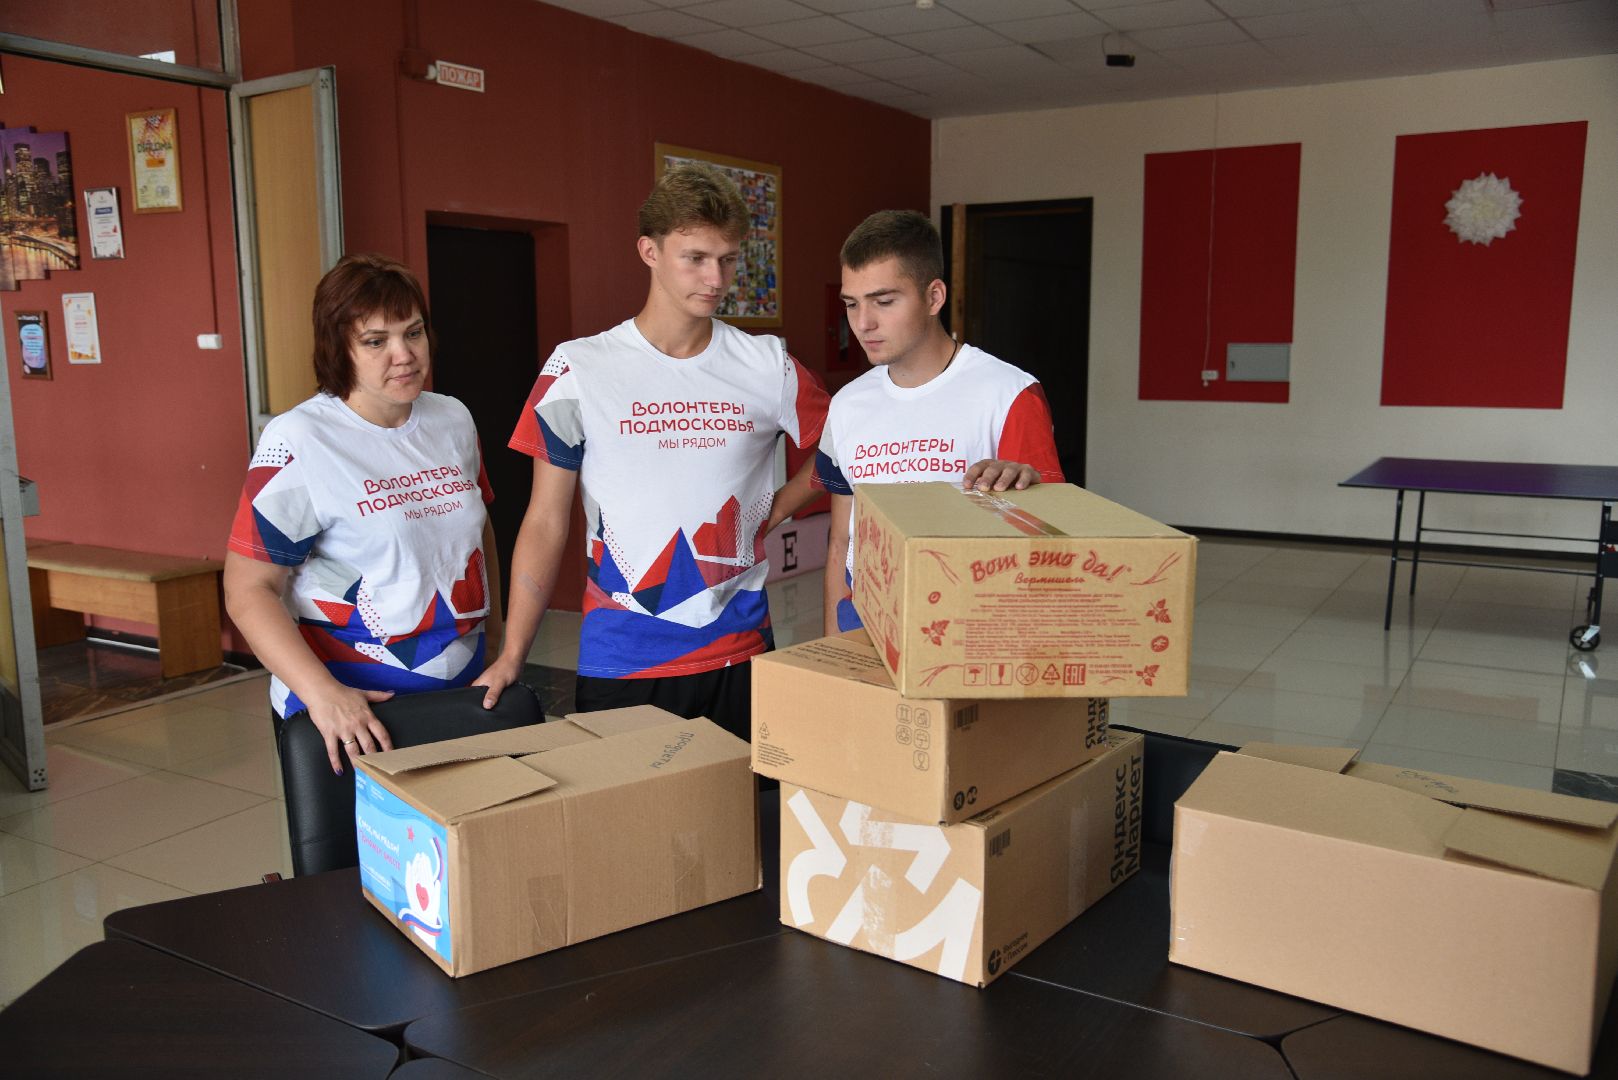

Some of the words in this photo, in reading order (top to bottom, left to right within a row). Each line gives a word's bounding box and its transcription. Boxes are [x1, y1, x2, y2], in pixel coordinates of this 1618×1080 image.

[440, 64, 481, 88] ПОЖАР
[632, 401, 745, 417] ВОЛОНТЕРЫ
[620, 418, 755, 435] ПОДМОСКОВЬЯ
[658, 439, 679, 449] МЫ
[682, 438, 727, 449] РЯДОМ
[855, 438, 955, 461] ВОЛОНТЕРЫ
[363, 465, 462, 495] ВОЛОНТЕРЫ
[356, 479, 477, 517] ПОДМОСКОВЬЯ
[404, 509, 424, 521] МЫ
[423, 500, 464, 518] РЯДОМ
[1028, 550, 1078, 568] это
[1014, 572, 1086, 588] Вермишель
[1110, 763, 1127, 884] Яндекс
[1125, 755, 1142, 876] Маркет
